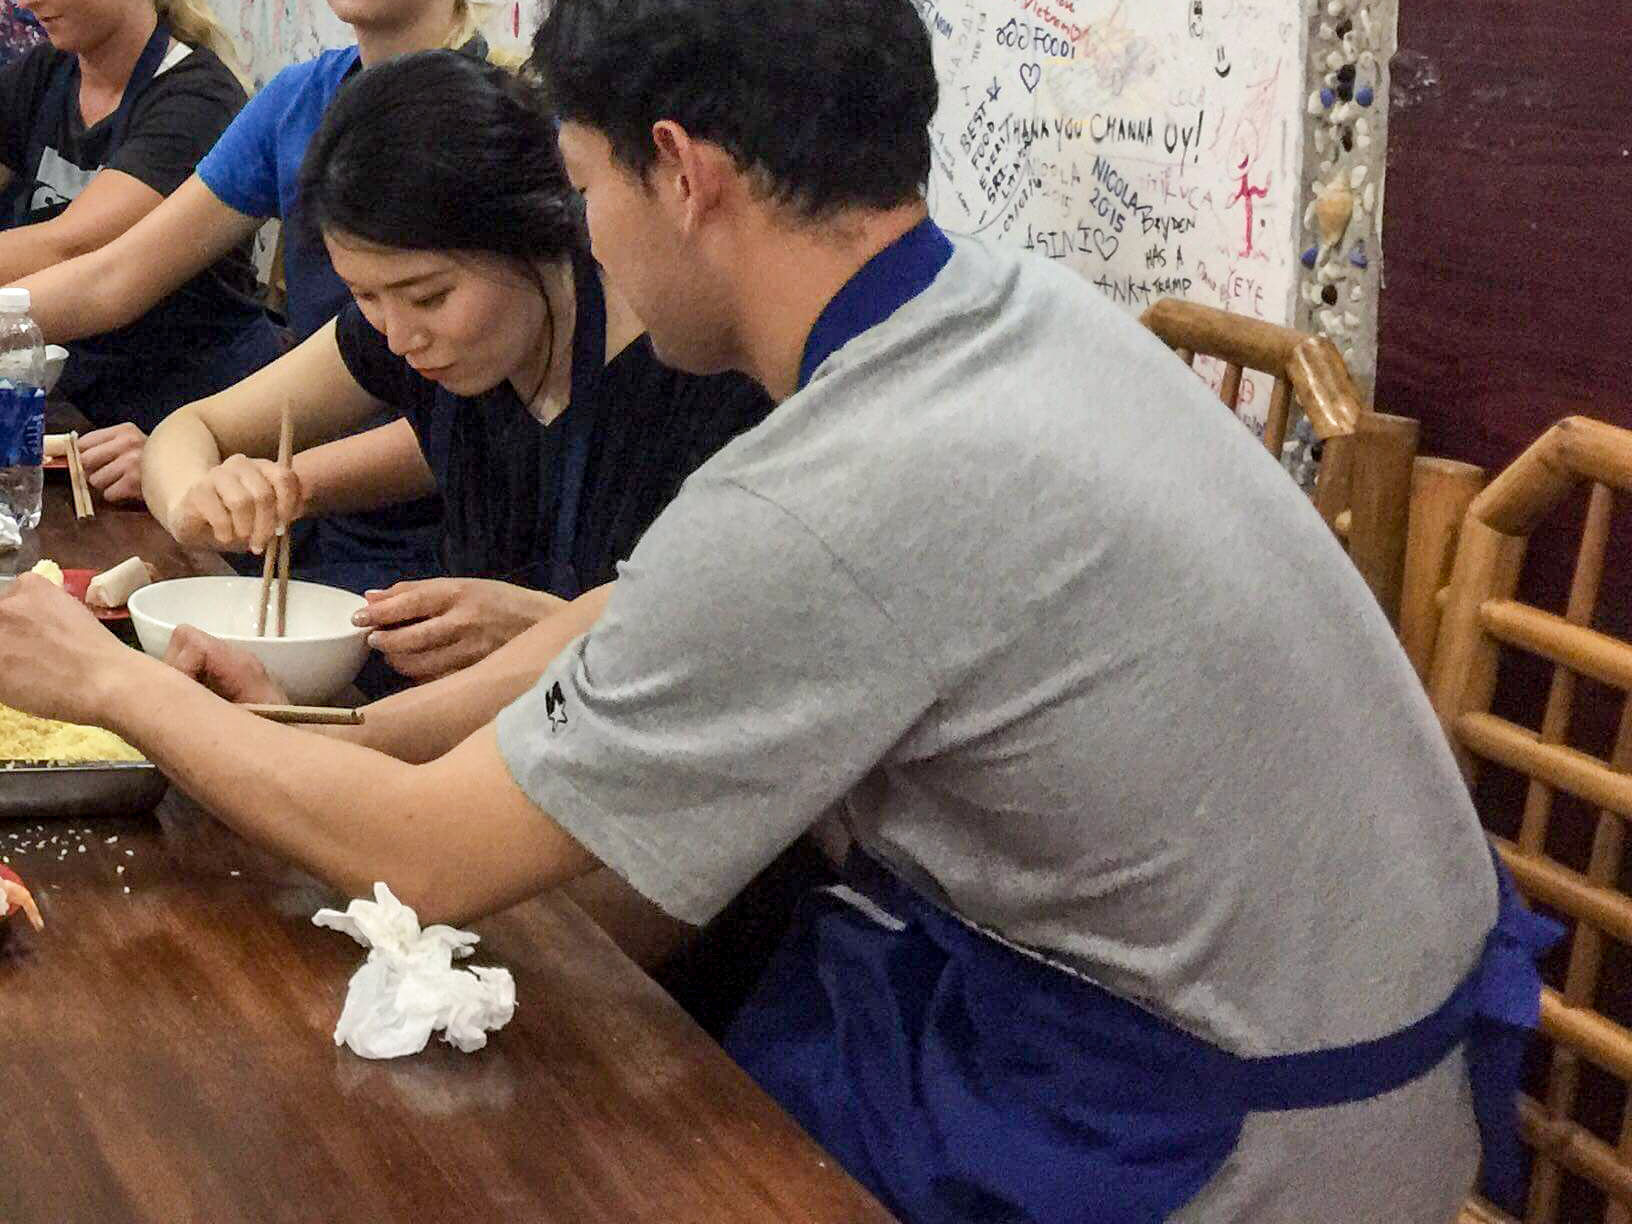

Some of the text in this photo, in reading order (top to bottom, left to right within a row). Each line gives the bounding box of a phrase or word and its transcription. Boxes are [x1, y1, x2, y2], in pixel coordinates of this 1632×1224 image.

[1054, 117, 1082, 153] YOU
[1090, 155, 1139, 216] NICOLA
[1088, 187, 1126, 234] 2015
